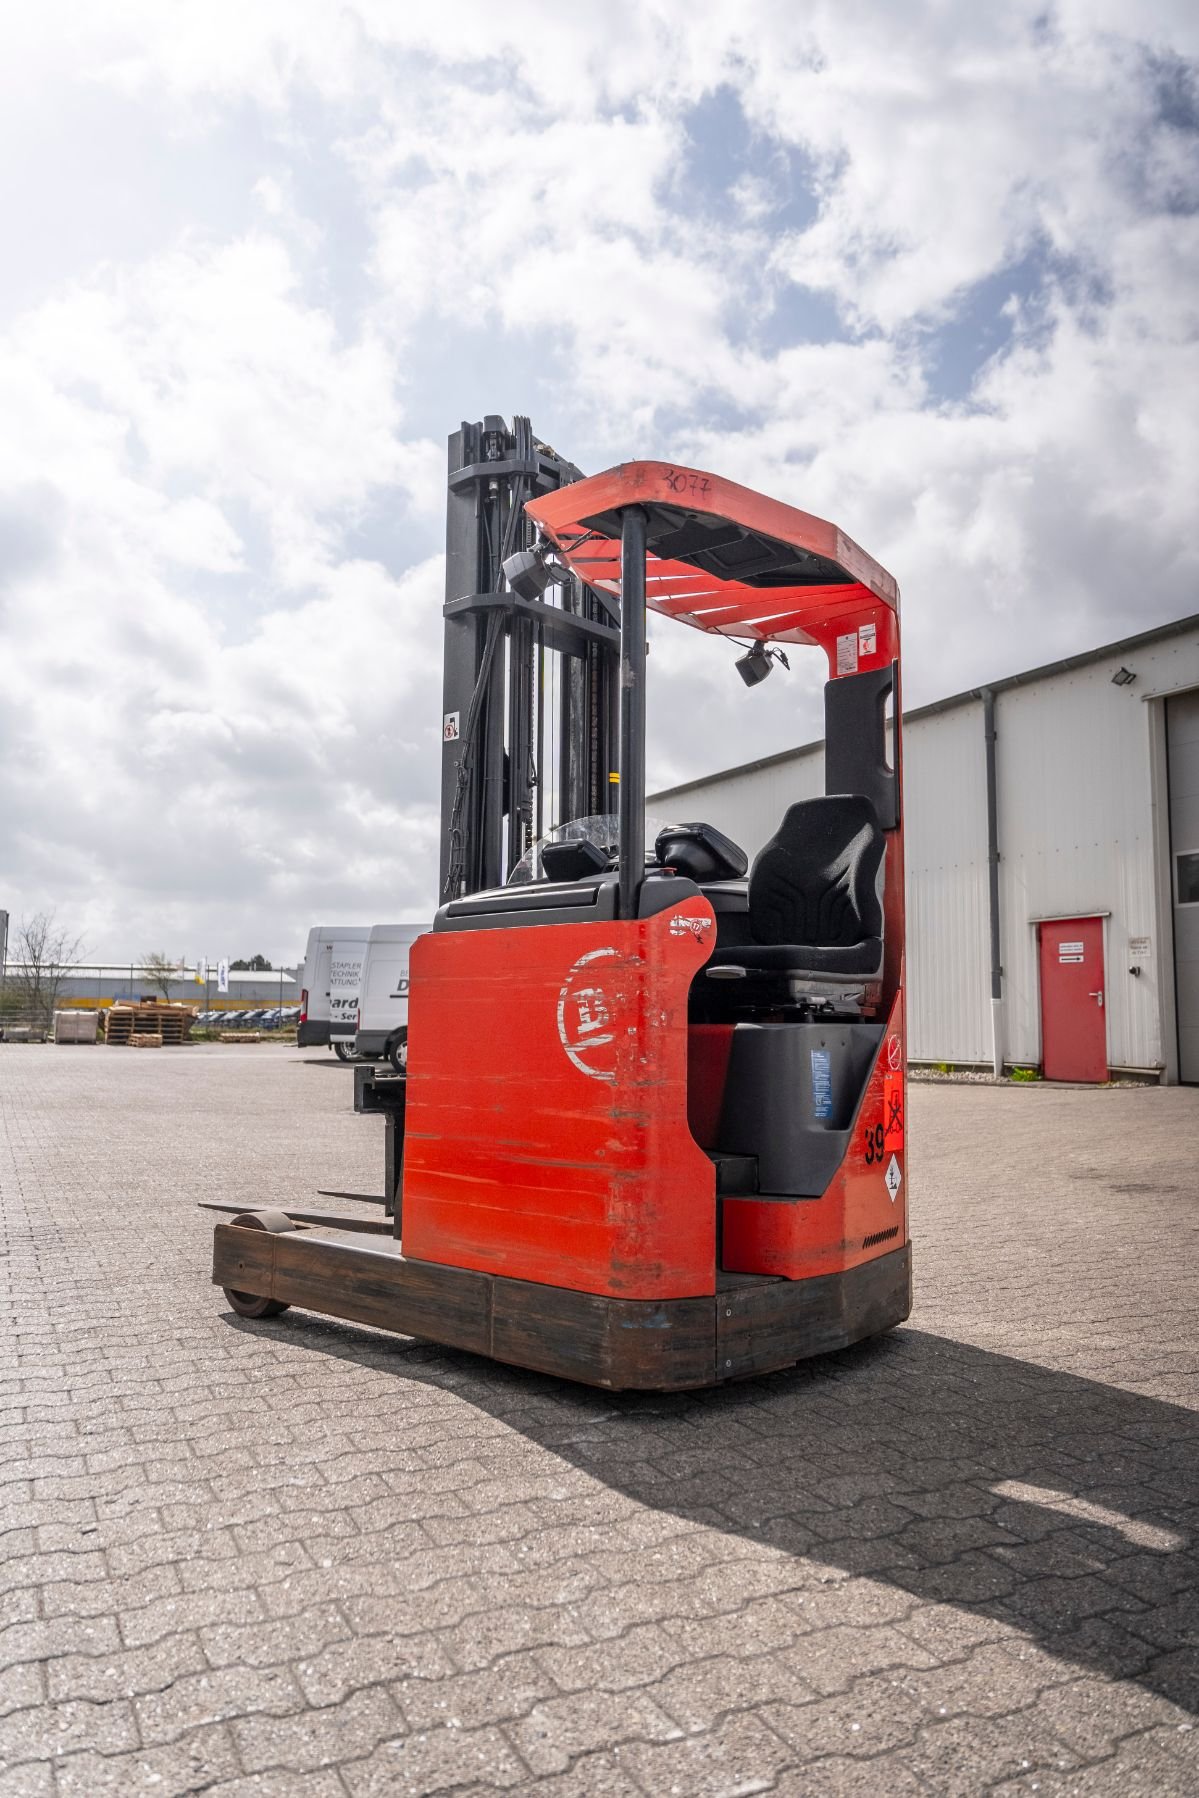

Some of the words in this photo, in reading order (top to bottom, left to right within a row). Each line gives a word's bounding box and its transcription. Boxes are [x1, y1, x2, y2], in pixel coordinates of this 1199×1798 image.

[662, 469, 711, 500] 3077
[330, 997, 359, 1009] ard
[865, 1123, 885, 1164] 39
